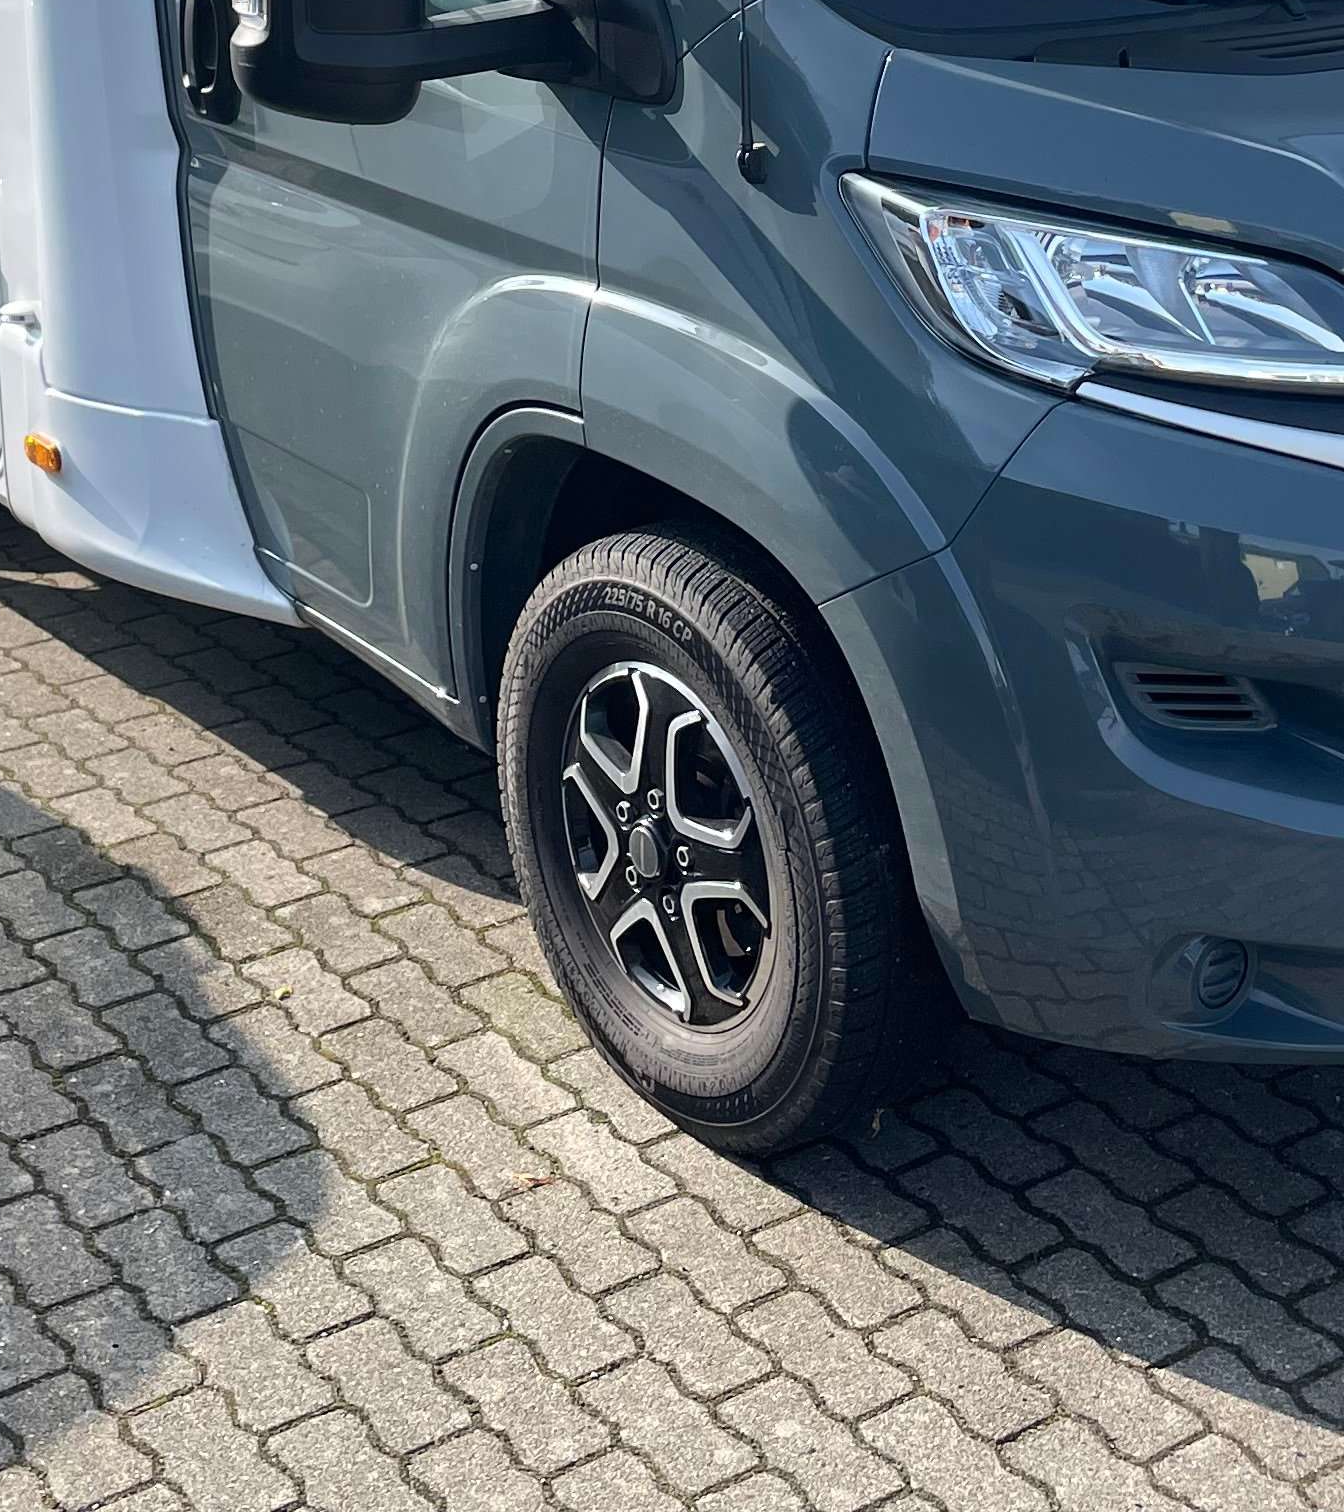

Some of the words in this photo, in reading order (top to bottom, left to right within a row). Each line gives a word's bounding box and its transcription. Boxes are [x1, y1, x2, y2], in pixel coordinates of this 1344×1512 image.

[604, 587, 644, 612] 225/75
[646, 599, 657, 620] R
[658, 607, 673, 629] 16
[673, 620, 693, 642] CP
